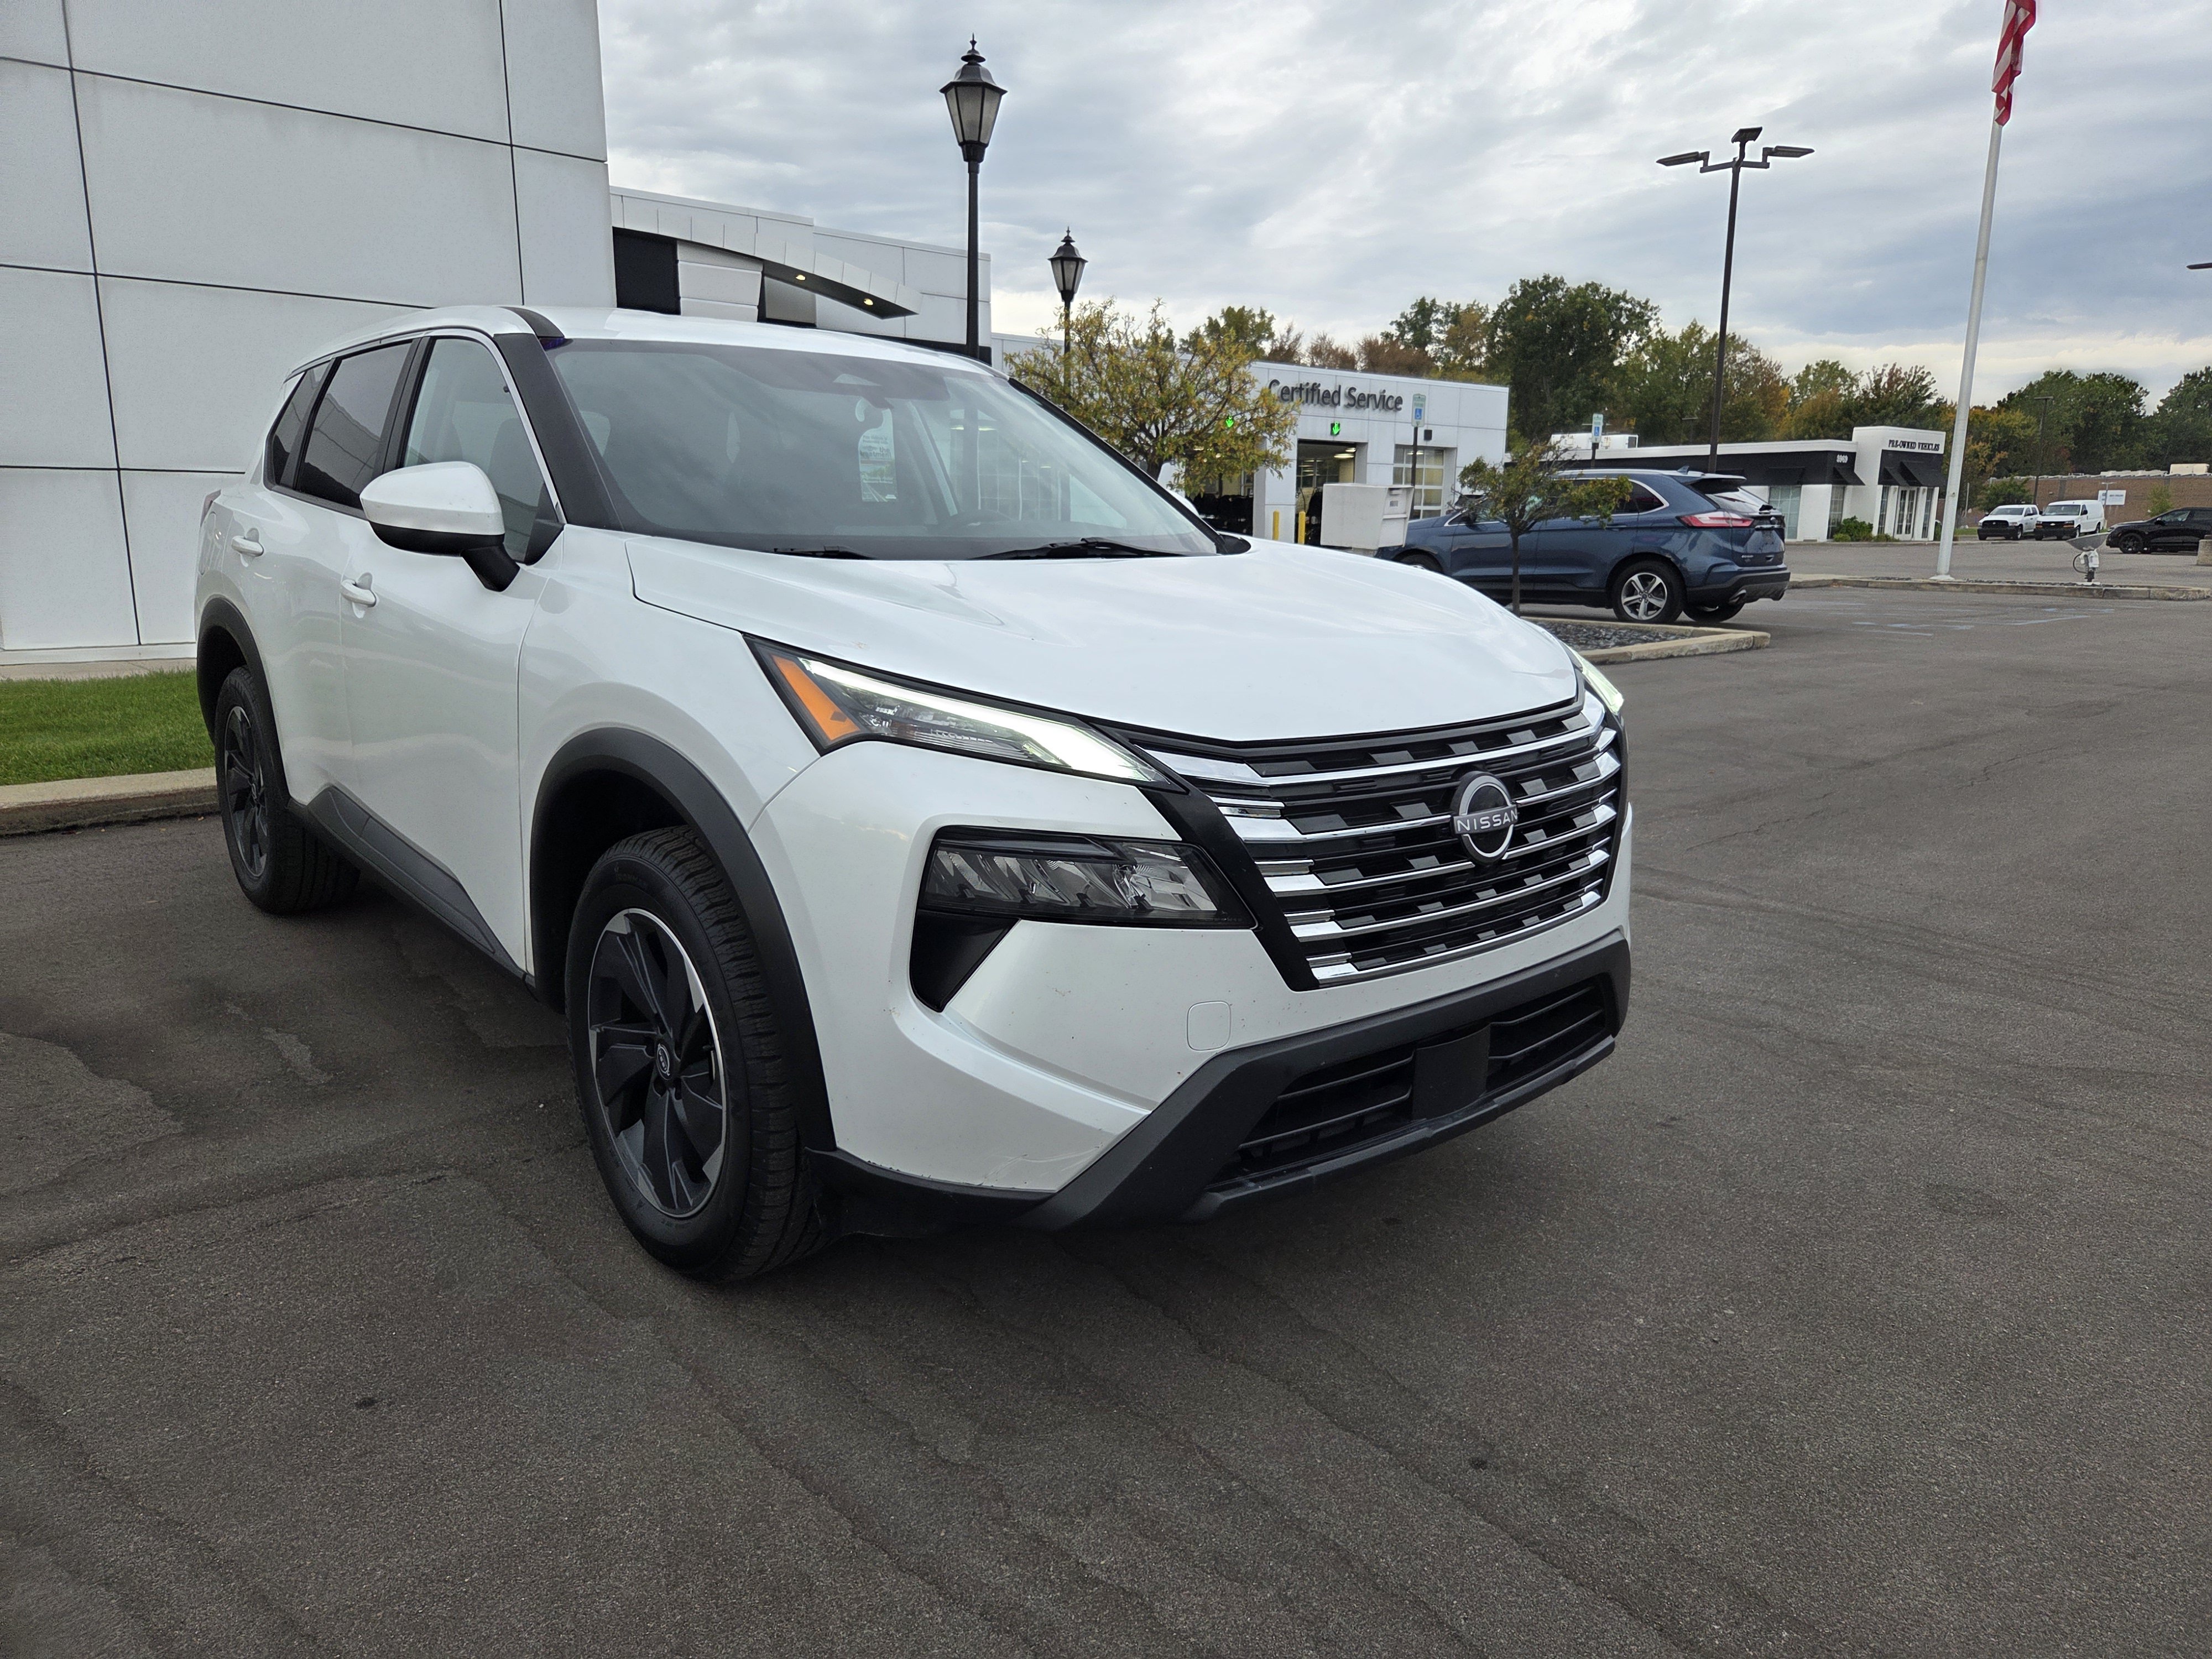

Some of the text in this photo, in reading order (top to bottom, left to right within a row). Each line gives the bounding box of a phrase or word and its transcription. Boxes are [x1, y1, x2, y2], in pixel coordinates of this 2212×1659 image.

[1268, 379, 1404, 411] Certified Service
[1888, 439, 1940, 452] PRE-OWNED VEHICLES
[1457, 808, 1518, 832] NISSAN
